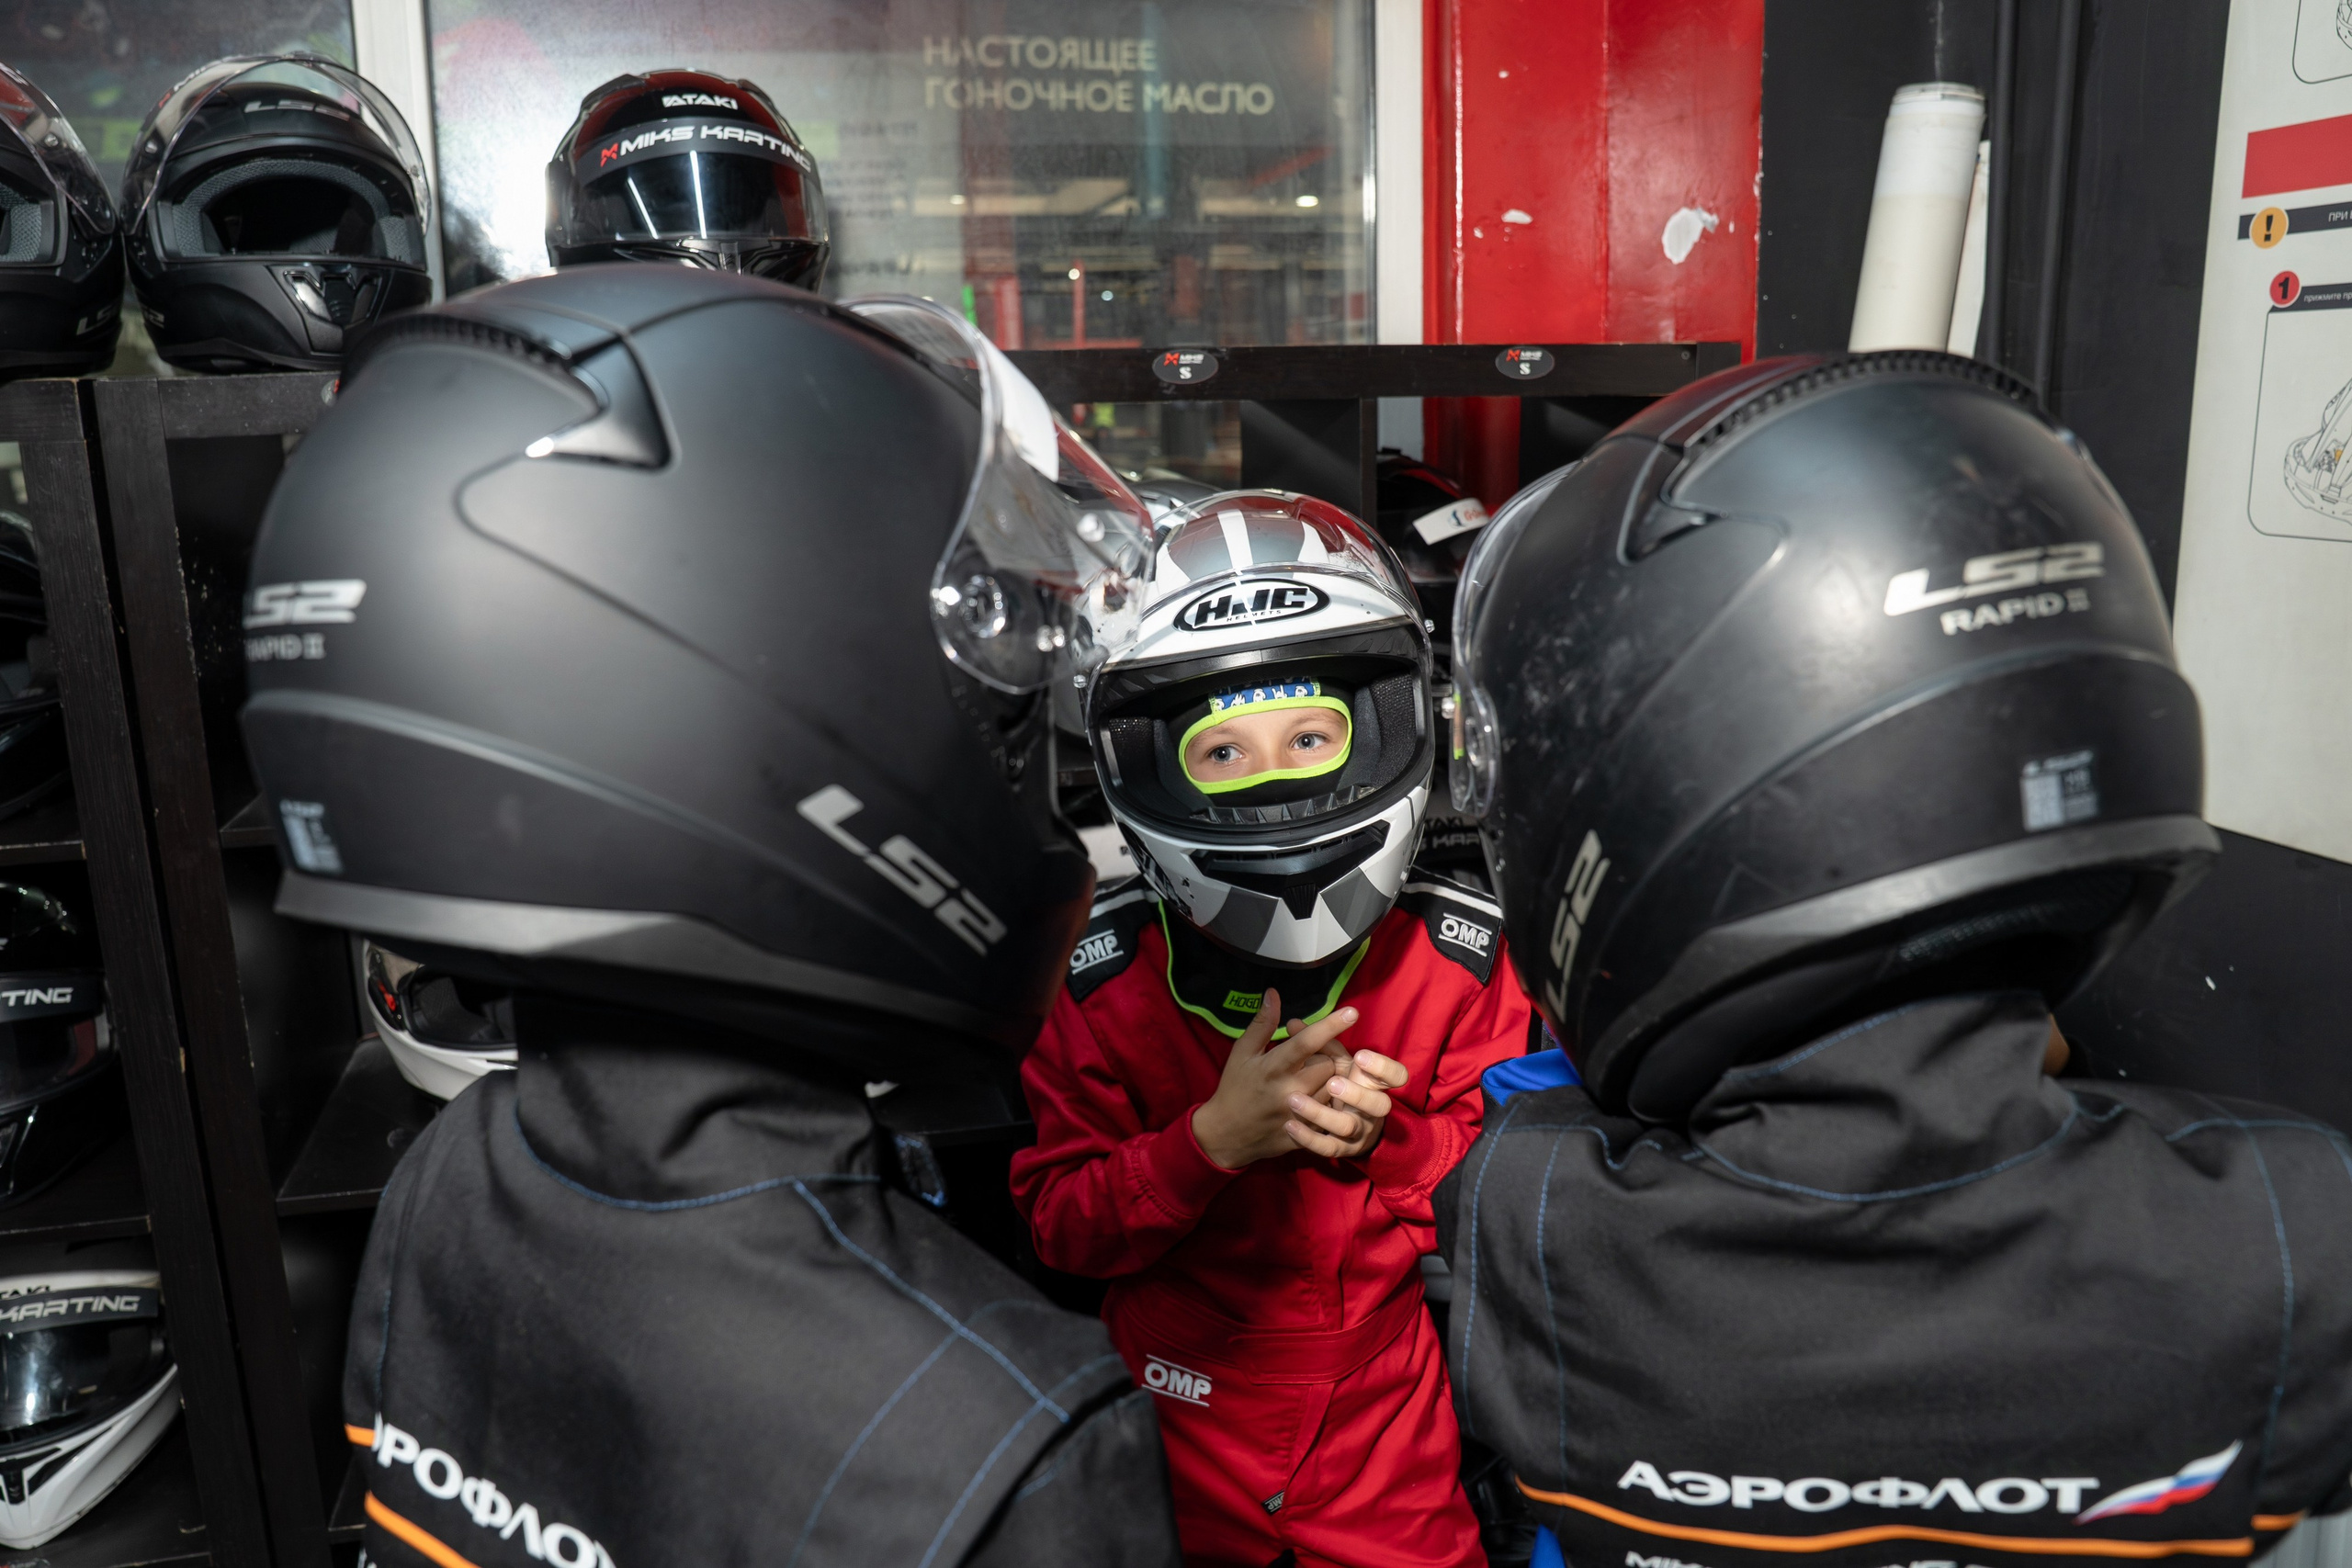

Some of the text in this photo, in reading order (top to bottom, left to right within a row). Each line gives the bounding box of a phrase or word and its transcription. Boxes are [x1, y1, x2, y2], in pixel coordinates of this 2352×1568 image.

[922, 35, 1158, 76] НАСТОЯЩЕЕ
[924, 75, 1136, 112] ГОНОЧНОЕ
[620, 125, 696, 156] MIKS
[2327, 210, 2348, 222] ПРИ
[2278, 276, 2290, 299] 1
[1179, 366, 1192, 379] S
[1520, 362, 1531, 375] S
[1883, 541, 2106, 616] LS2
[243, 578, 367, 629] S2
[1194, 587, 1308, 626] HJC
[1227, 609, 1283, 622] HELMETS
[1939, 591, 2066, 636] RAPID
[796, 784, 1008, 957] LS2
[1442, 919, 1489, 949] OMP
[1545, 829, 1611, 1024] LS2
[1069, 934, 1118, 968] OMP
[1144, 1362, 1212, 1400] OMP
[371, 1411, 616, 1568] РОФЛО
[1617, 1460, 2100, 1514] АЭРОФЛОТ
